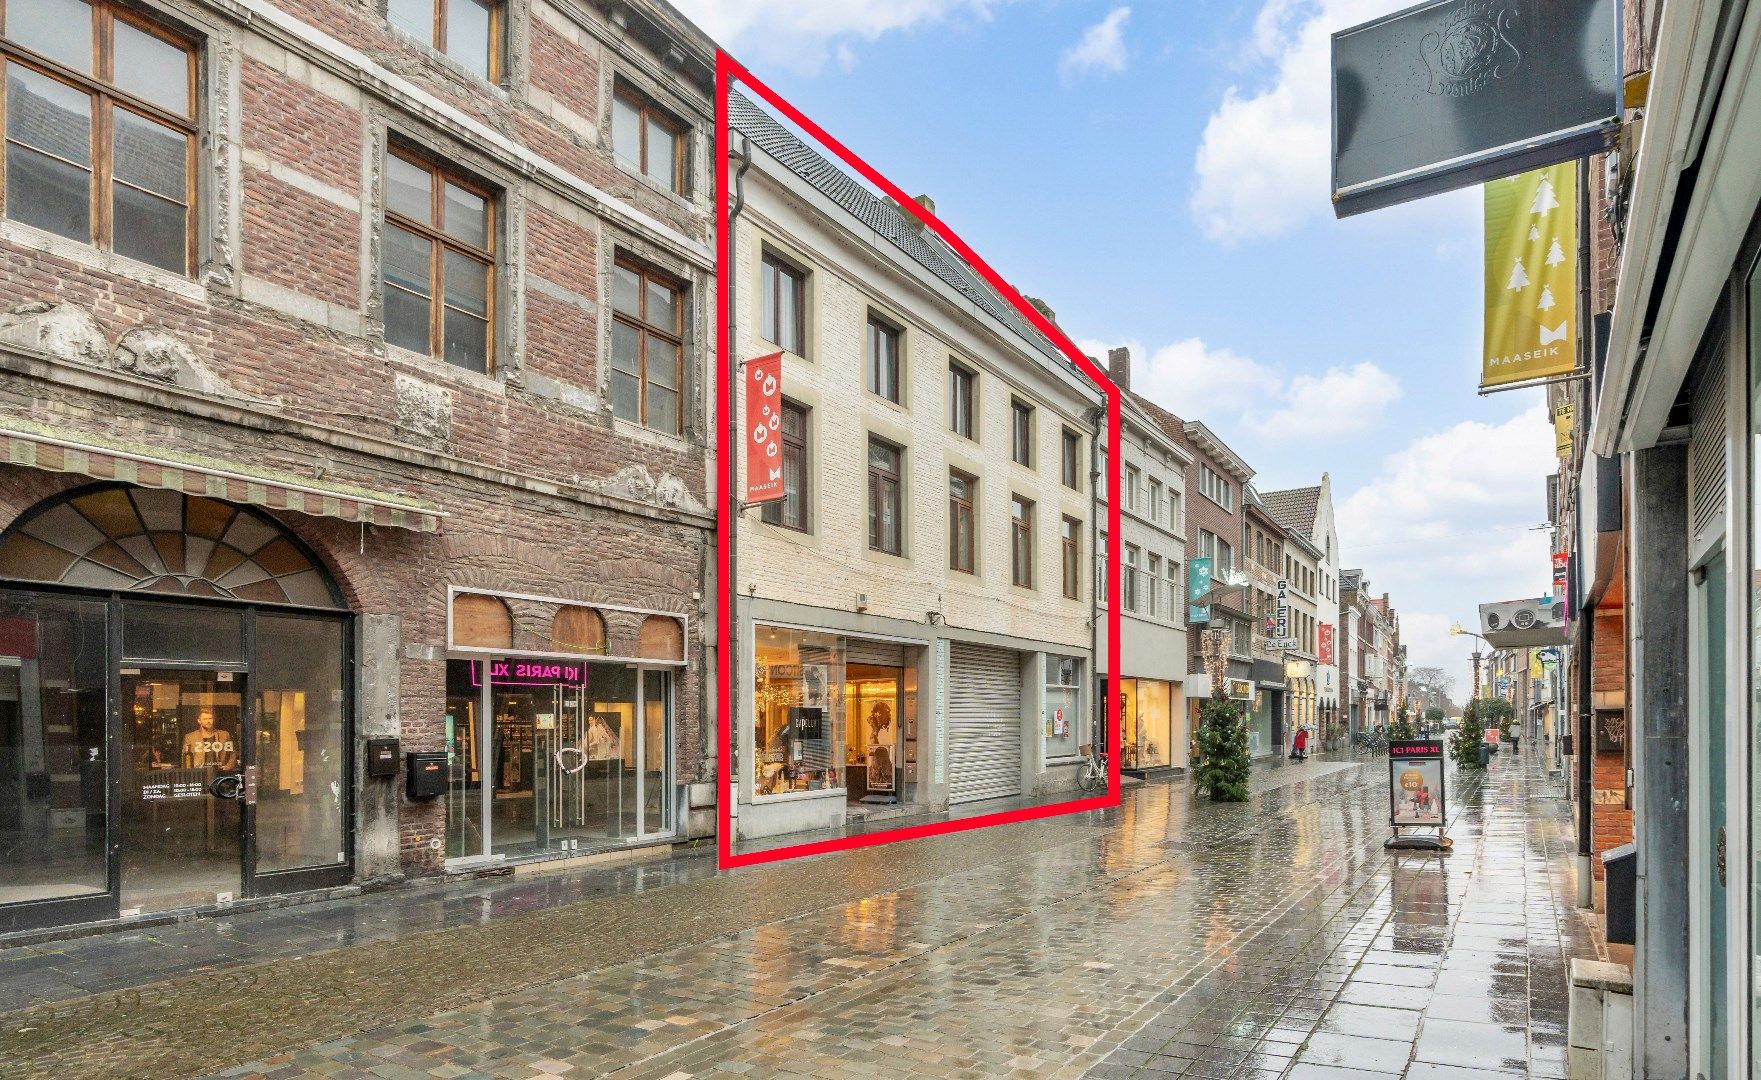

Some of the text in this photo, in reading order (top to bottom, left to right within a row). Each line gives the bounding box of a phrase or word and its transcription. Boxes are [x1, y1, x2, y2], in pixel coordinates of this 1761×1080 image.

[1488, 346, 1560, 367] MAASEIK
[749, 481, 778, 492] MAASEIK
[1392, 746, 1404, 754] ICI
[1405, 746, 1428, 754] PARIS
